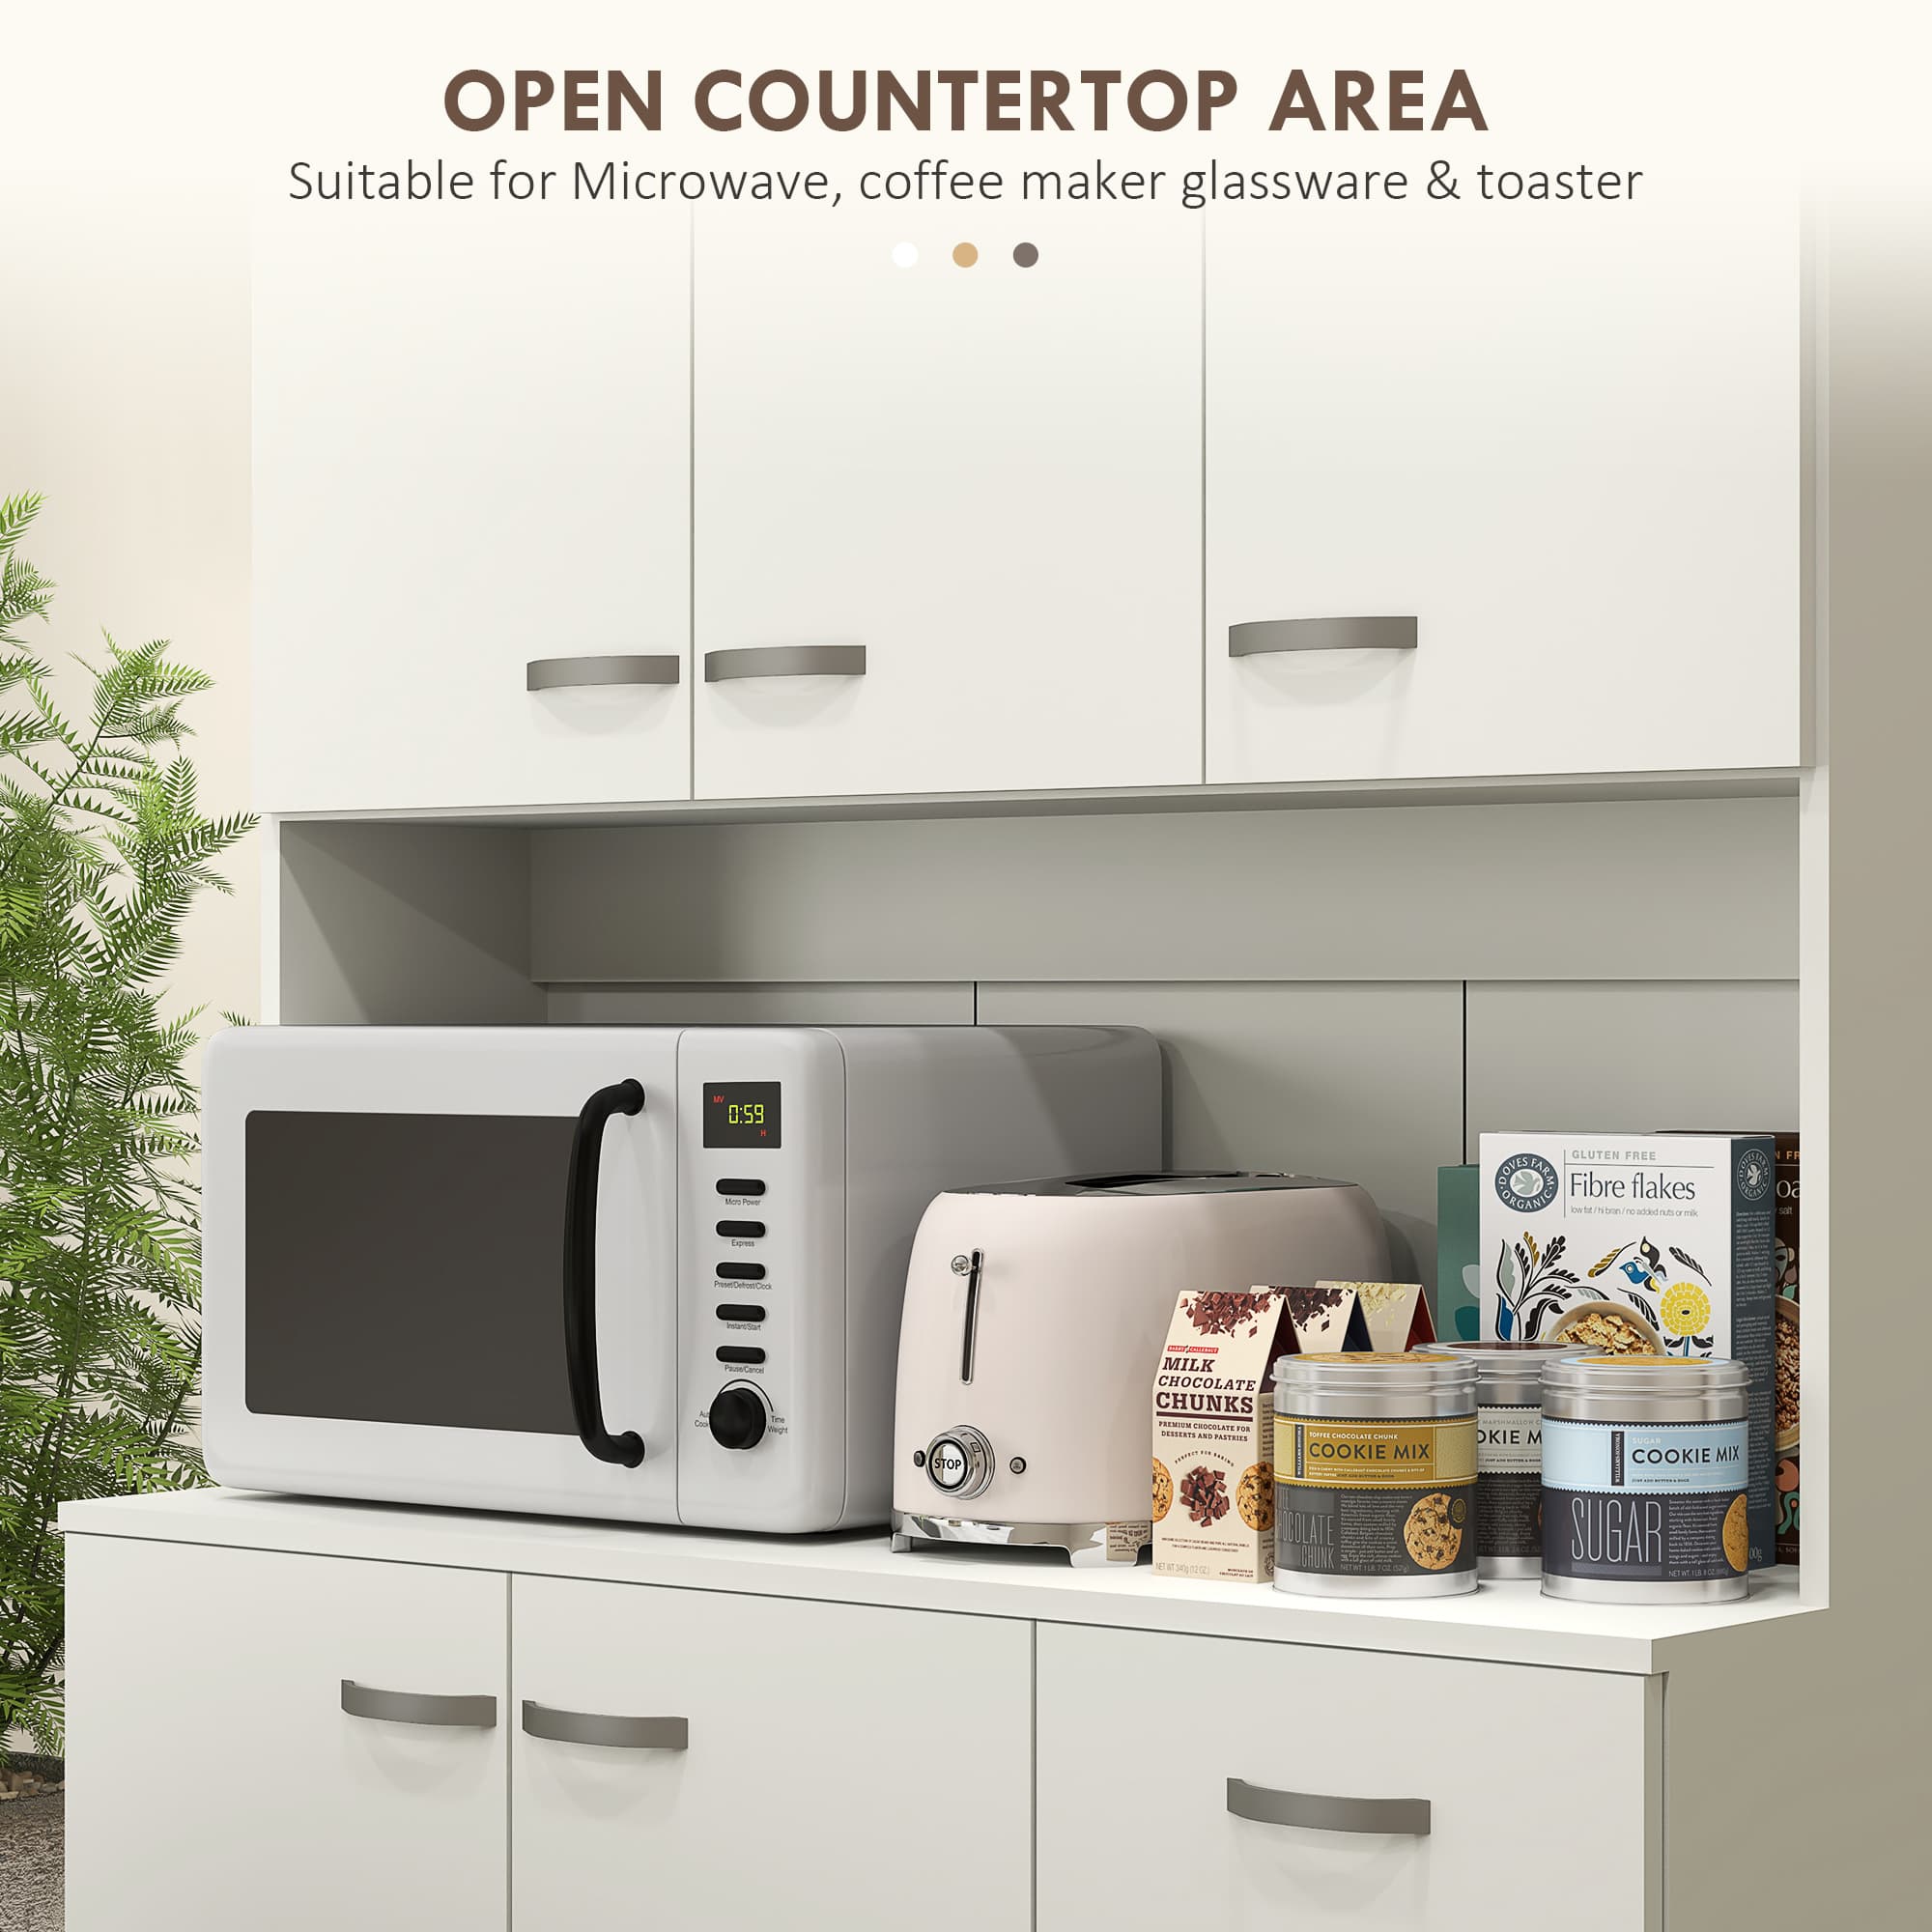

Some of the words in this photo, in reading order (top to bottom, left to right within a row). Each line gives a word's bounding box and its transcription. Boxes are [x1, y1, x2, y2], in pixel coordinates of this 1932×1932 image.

[728, 1104, 764, 1124] 0:59
[1572, 1150, 1620, 1160] GLUTEN
[1625, 1151, 1657, 1161] FREE
[1498, 1156, 1529, 1185] DOVES
[1530, 1157, 1554, 1186] FARM
[1570, 1170, 1627, 1199] Fibre
[1631, 1171, 1696, 1201] flakes
[725, 1198, 742, 1207] Micro
[742, 1198, 761, 1207] Power
[1502, 1189, 1552, 1209] ORGANIC
[1570, 1205, 1582, 1214] low
[1583, 1205, 1593, 1214] fat
[1605, 1206, 1621, 1215] bran
[1636, 1207, 1659, 1217] added
[1659, 1208, 1675, 1217] nuts
[1684, 1208, 1698, 1217] milk
[1778, 1206, 1793, 1215] salt
[731, 1238, 755, 1248] Express
[714, 1280, 773, 1291] Preset/Defrost/Clock
[726, 1321, 761, 1331] Instant/Start
[724, 1364, 764, 1375] Pause/Cancel
[1161, 1356, 1216, 1373] MILK
[1157, 1375, 1257, 1392] CHOCOLATE
[1155, 1391, 1254, 1414] CHUNKS
[771, 1415, 785, 1424] Time
[767, 1425, 789, 1435] Weight
[1158, 1420, 1192, 1430] PREMIUM
[1193, 1422, 1236, 1433] CHOCOLATE
[1236, 1425, 1252, 1434] FOR
[1161, 1430, 1197, 1439] DESSERTS
[1214, 1434, 1249, 1443] PASTRIES
[1309, 1431, 1331, 1439] TOFFEE
[1331, 1432, 1373, 1440] CHOCOLATE
[1477, 1429, 1521, 1445] OKIE
[1631, 1436, 1662, 1446] SUGAR
[1309, 1441, 1387, 1461] COOKIE
[1393, 1443, 1430, 1461] MIX
[1632, 1447, 1712, 1464] COOKIE
[1716, 1444, 1741, 1463] MIX
[934, 1457, 963, 1471] STOP
[1571, 1496, 1662, 1564] SUGAR
[1300, 1545, 1335, 1570] CHUNK
[1748, 1546, 1763, 1562] 00g
